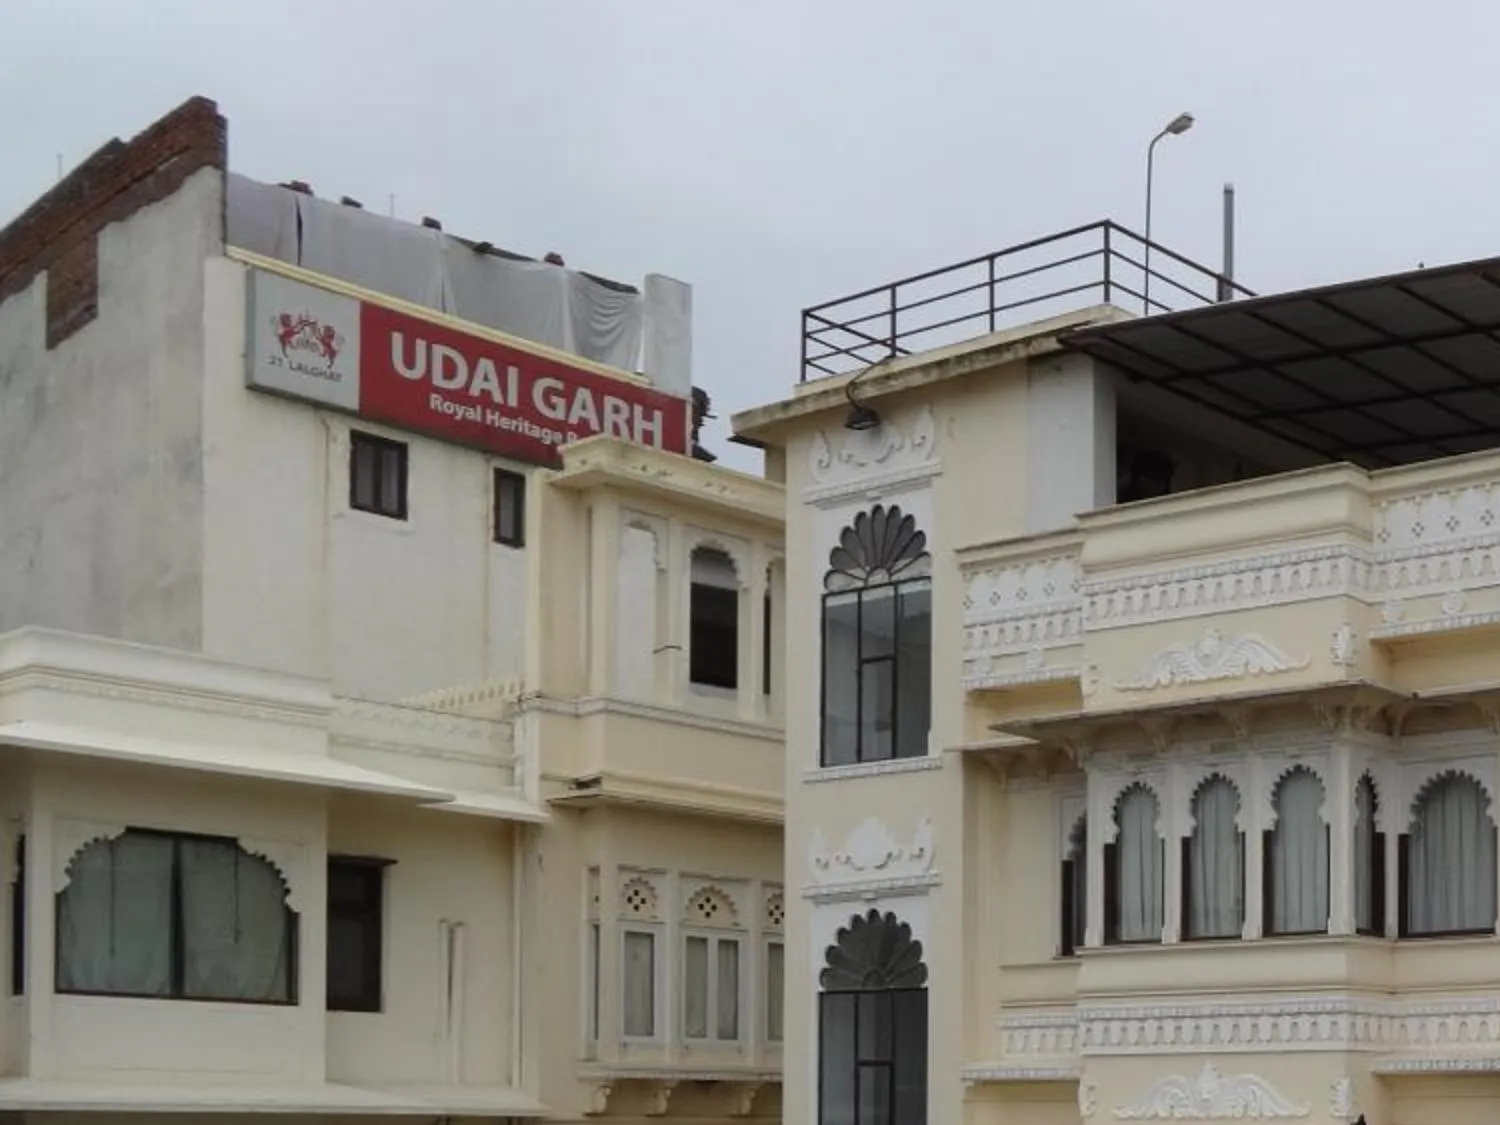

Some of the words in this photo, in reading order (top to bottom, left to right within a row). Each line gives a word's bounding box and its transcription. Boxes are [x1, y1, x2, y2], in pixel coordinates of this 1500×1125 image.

[391, 331, 519, 408] UDAI
[531, 377, 664, 450] GARH
[430, 394, 482, 422] Royal
[486, 410, 563, 444] Heritage
